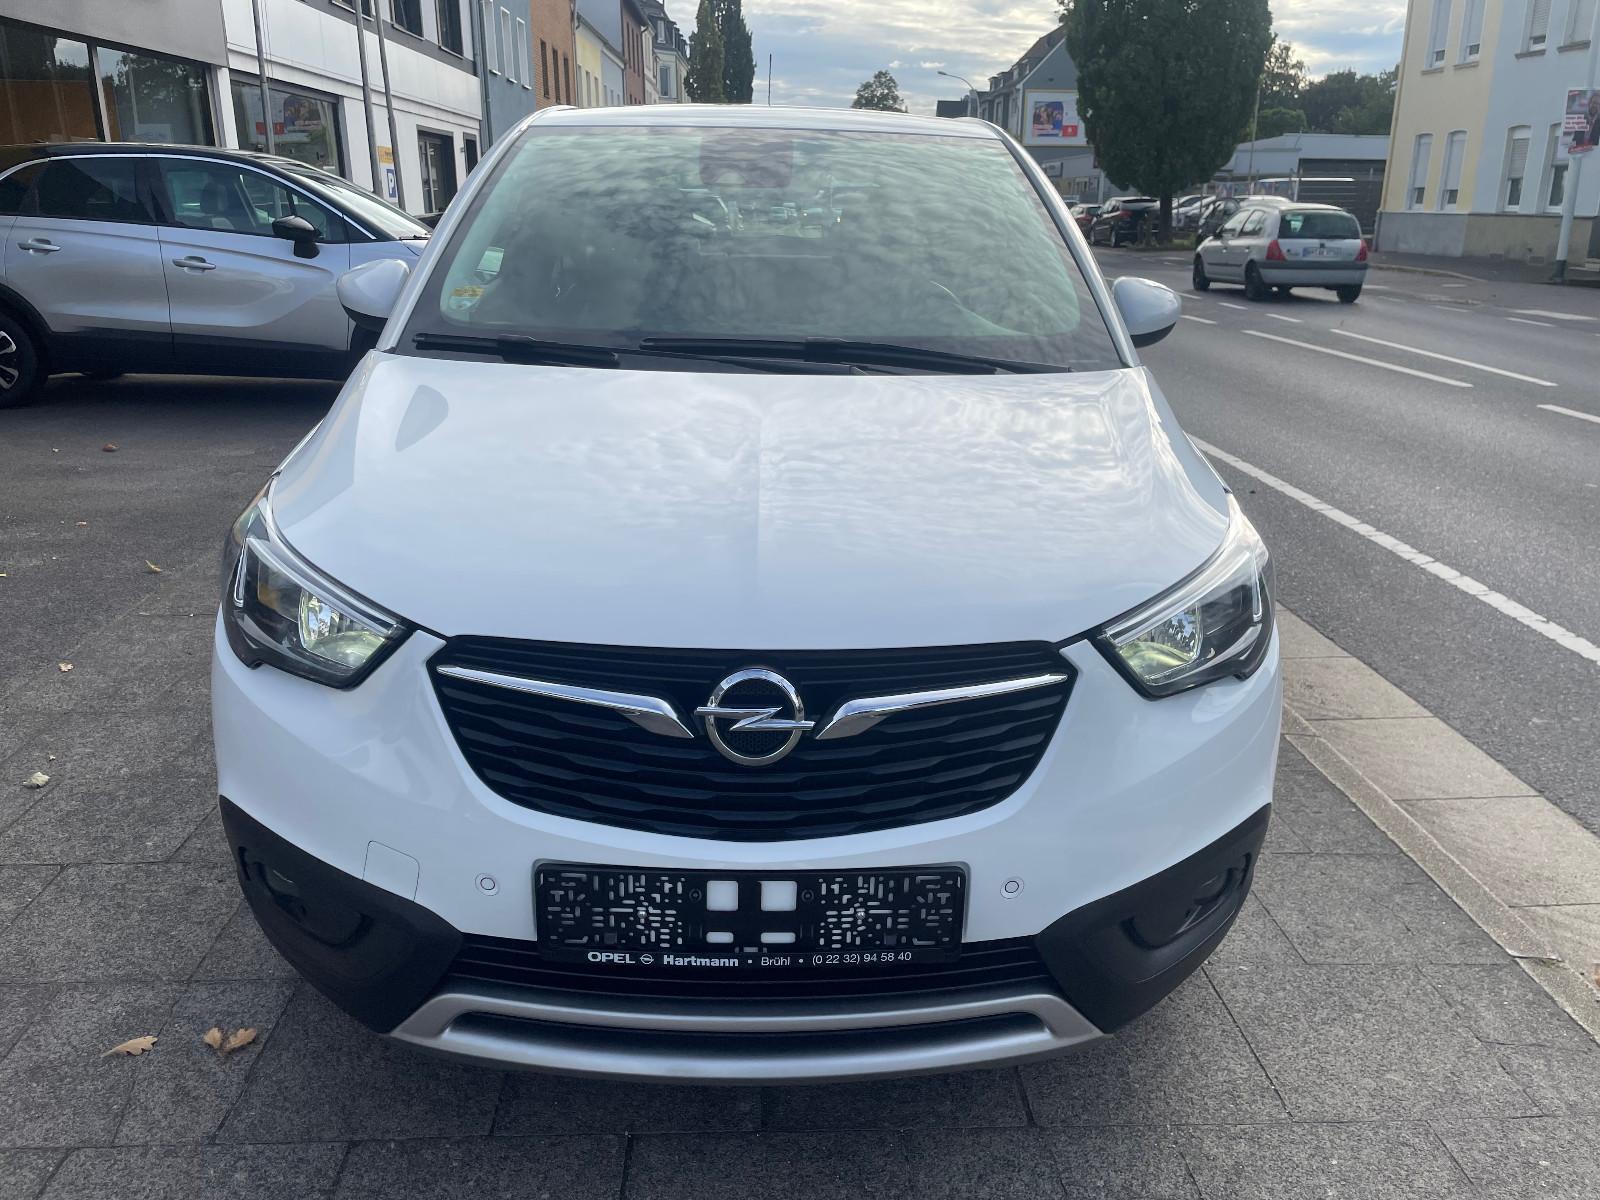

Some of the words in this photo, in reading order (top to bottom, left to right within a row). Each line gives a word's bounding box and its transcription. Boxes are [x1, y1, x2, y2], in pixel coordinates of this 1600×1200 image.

[587, 951, 636, 964] OPEL
[663, 954, 739, 967] Hartmann
[760, 956, 791, 966] Brühl
